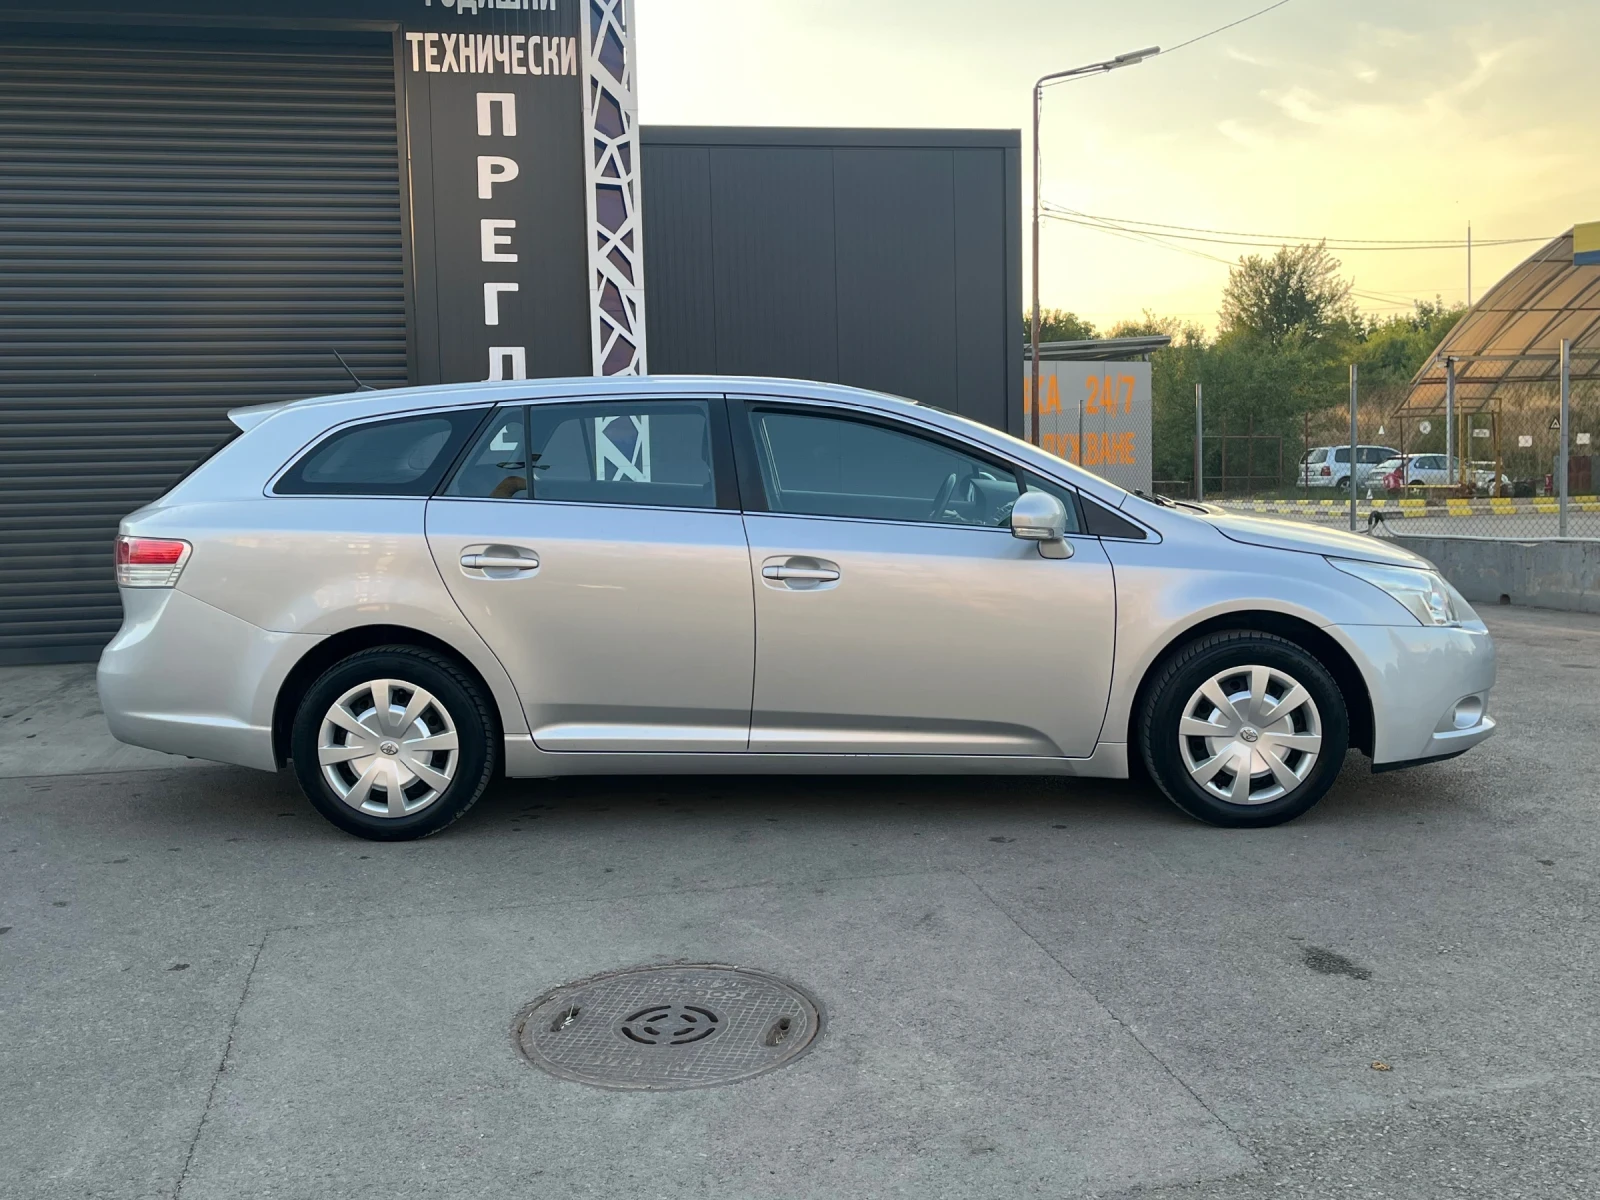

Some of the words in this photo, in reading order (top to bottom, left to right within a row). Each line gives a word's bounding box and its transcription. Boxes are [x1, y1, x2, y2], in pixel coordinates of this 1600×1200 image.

[406, 32, 577, 76] ТЕХНИЧЕСКИ
[1024, 373, 1062, 415] КА
[1086, 372, 1136, 419] 24/7
